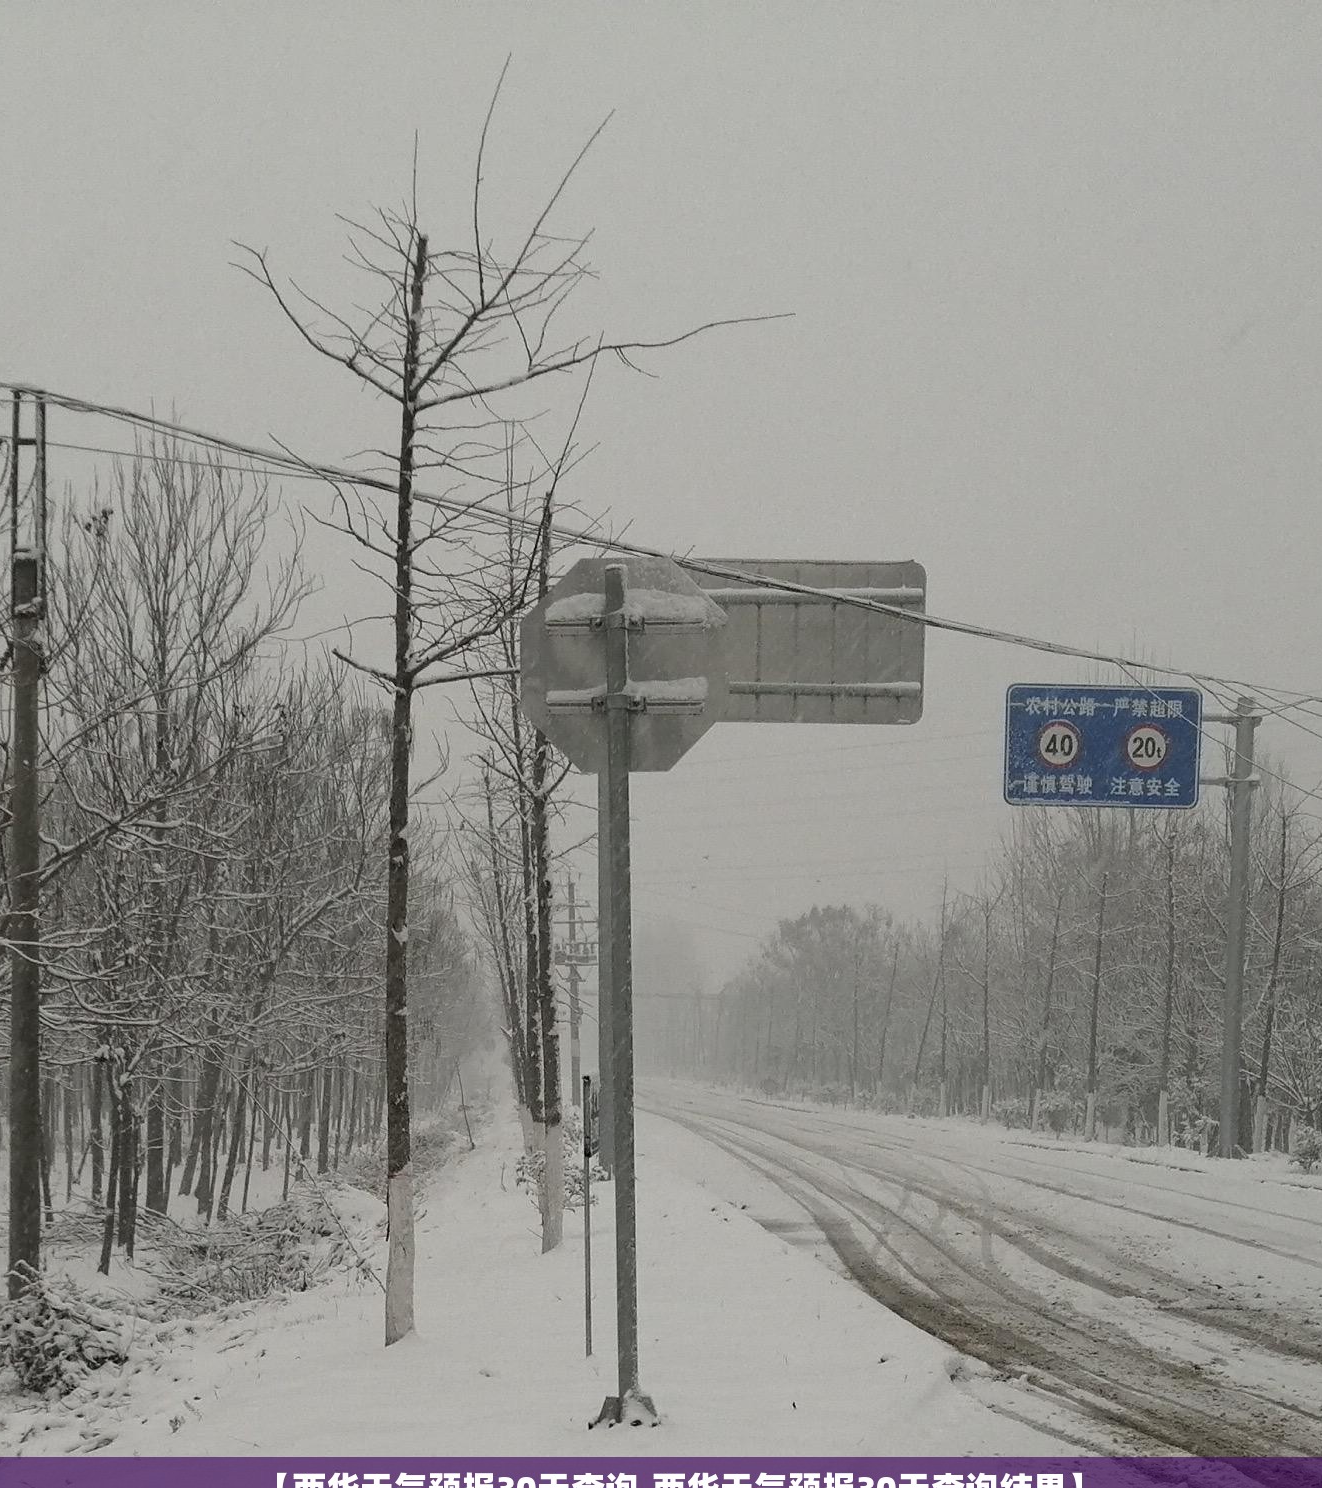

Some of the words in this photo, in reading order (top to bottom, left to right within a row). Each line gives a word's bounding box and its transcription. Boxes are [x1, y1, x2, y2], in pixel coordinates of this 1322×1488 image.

[1025, 697, 1096, 716] 农村公路
[1113, 698, 1184, 718] 严禁超限
[1045, 734, 1073, 757] 40
[1132, 737, 1162, 759] 20t
[1023, 774, 1093, 795] 谨慎驾驶
[1110, 776, 1181, 797] 注意安全
